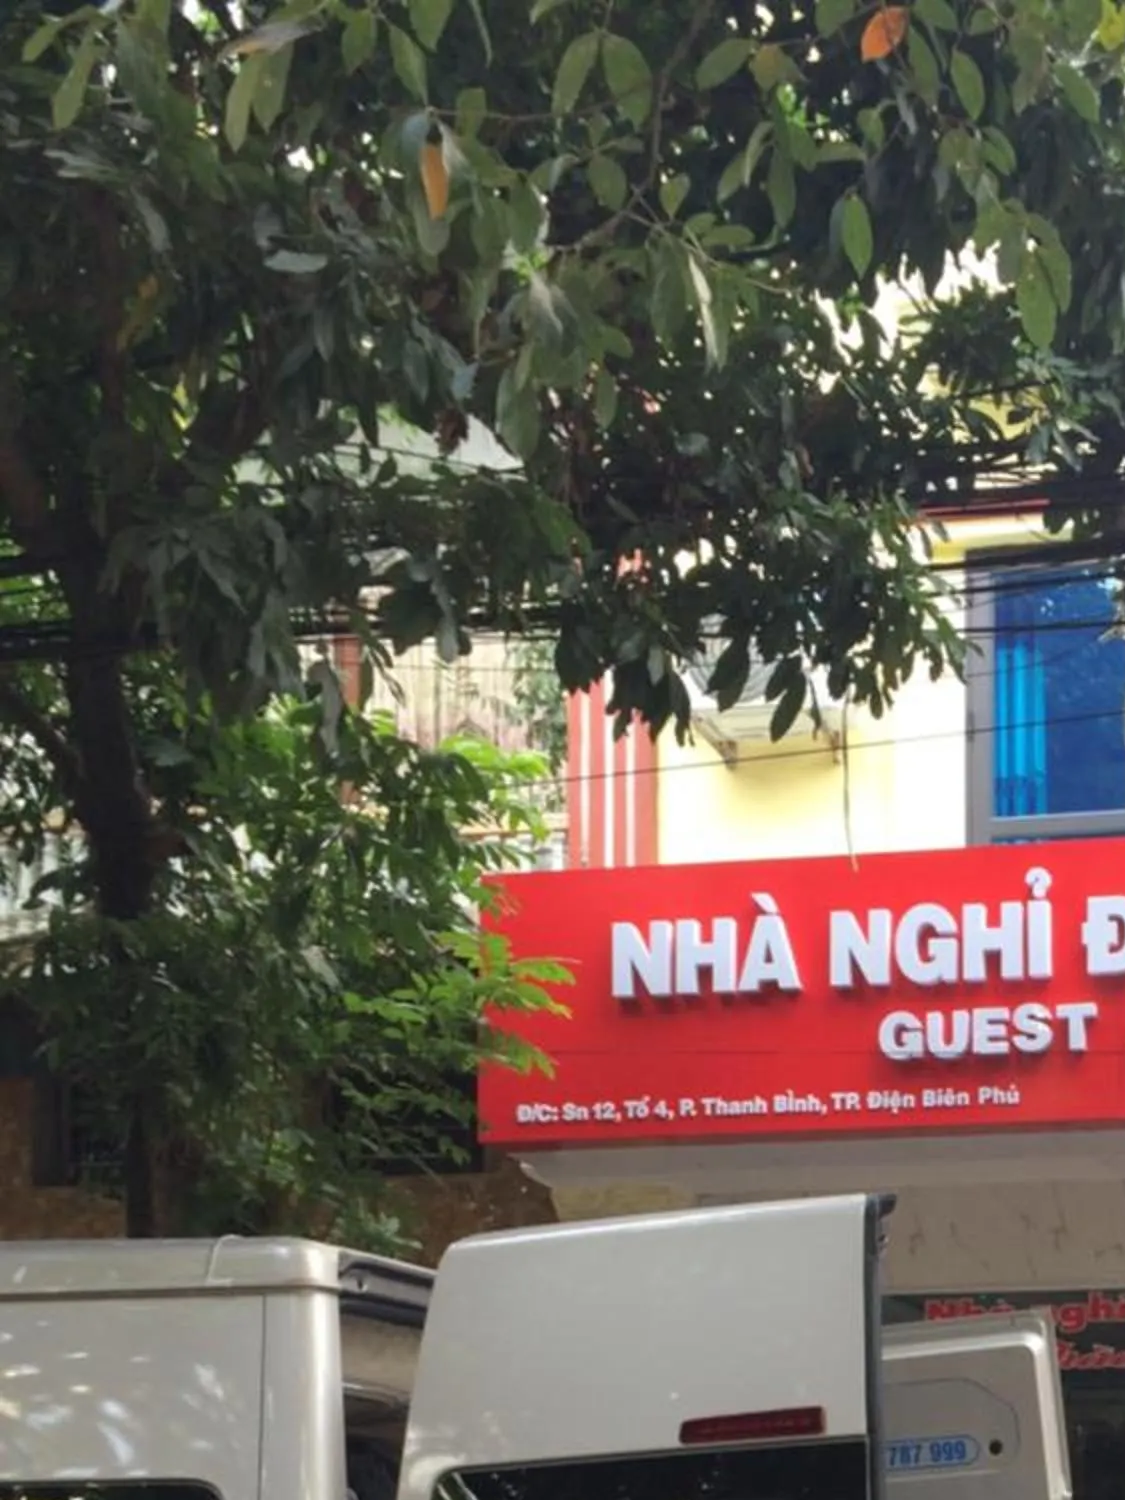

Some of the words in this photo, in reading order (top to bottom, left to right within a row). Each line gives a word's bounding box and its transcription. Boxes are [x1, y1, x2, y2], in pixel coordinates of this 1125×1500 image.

[611, 892, 801, 998] NHÀ
[829, 866, 1054, 988] NGHỈ
[879, 1002, 1098, 1060] GUEST
[561, 1102, 589, 1121] Sn
[593, 1102, 622, 1122] 12,
[653, 1100, 675, 1120] 4,
[679, 1098, 698, 1117] P.
[701, 1096, 768, 1117] Thanh
[866, 1089, 916, 1114] Điện
[922, 1087, 970, 1108] Biên
[929, 1439, 968, 1462] 999
